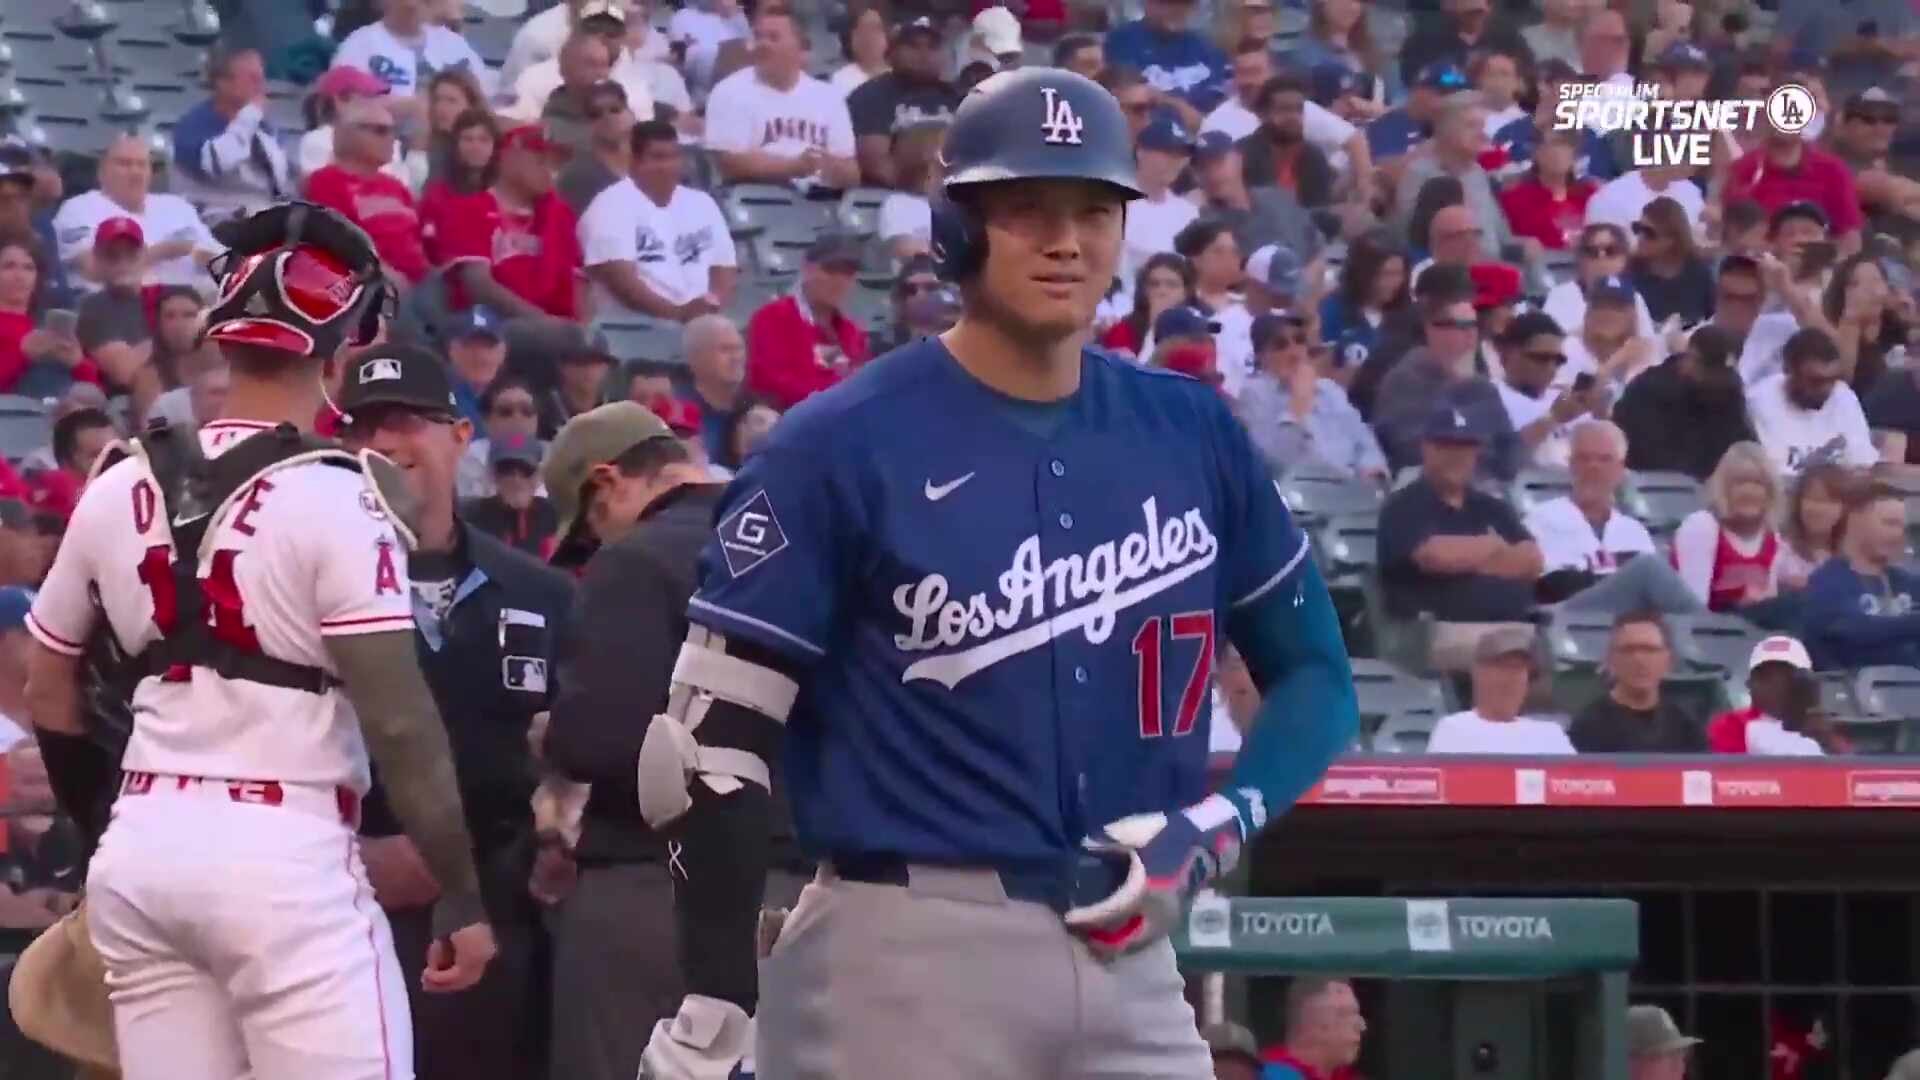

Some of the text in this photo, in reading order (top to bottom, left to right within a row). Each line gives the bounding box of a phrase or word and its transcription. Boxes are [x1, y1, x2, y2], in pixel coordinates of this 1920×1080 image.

[1040, 87, 1083, 144] LA
[893, 495, 1218, 651] Los Angeles
[1131, 608, 1216, 738] 17
[1239, 911, 1335, 936] TOYOTA
[1457, 915, 1553, 939] TOYOTA
